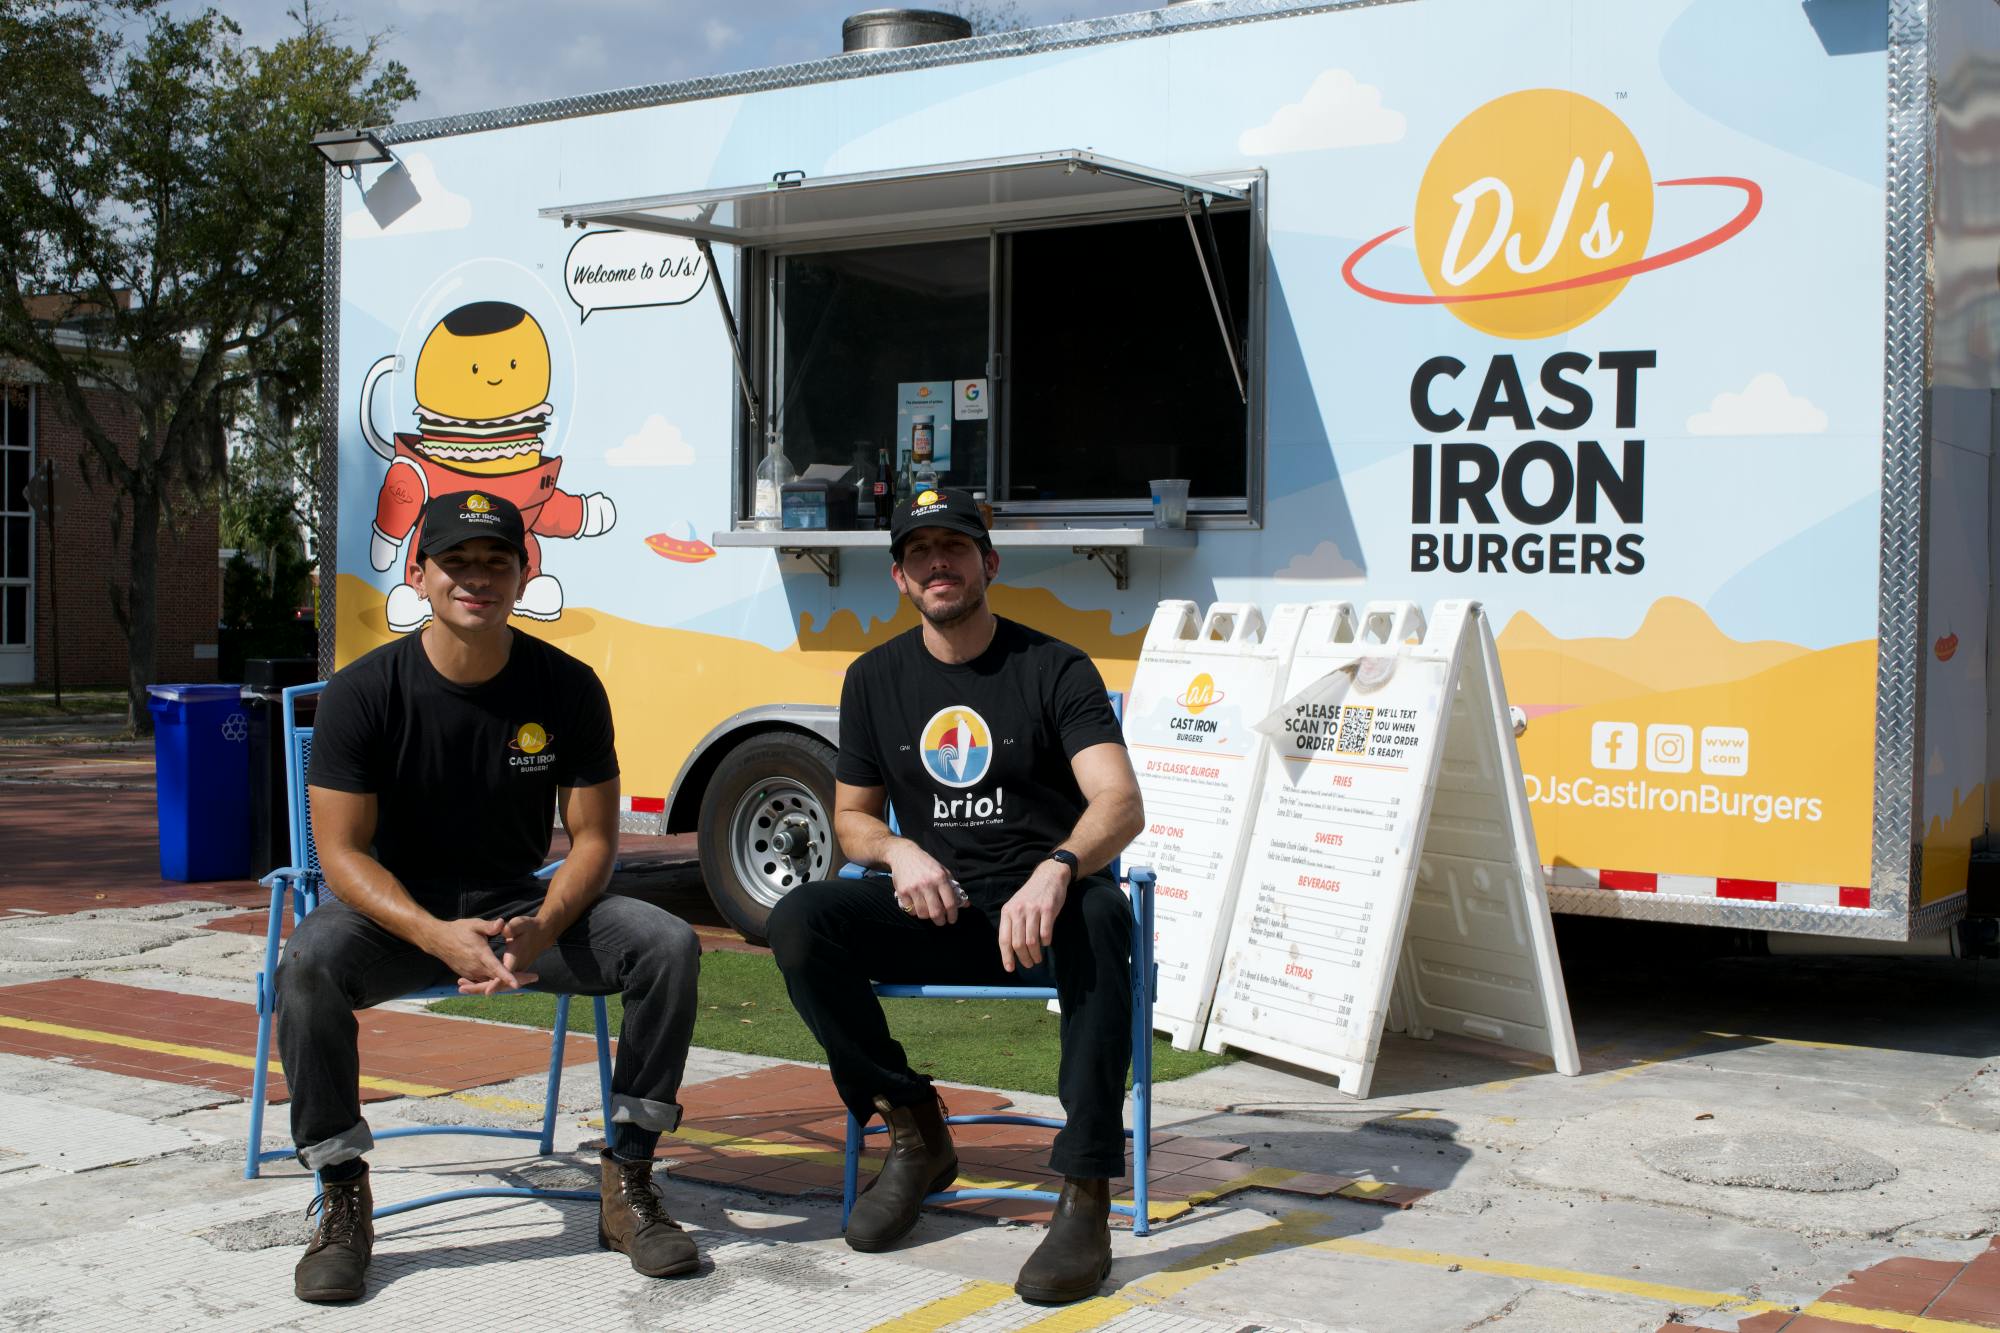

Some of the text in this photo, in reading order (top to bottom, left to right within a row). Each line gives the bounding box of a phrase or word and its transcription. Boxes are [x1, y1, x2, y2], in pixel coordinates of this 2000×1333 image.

[1441, 151, 1625, 286] DJ's
[574, 256, 702, 285] Welcome to DJ's!
[1410, 350, 1657, 434] CAST
[1411, 440, 1645, 526] IRON
[482, 513, 501, 522] IRON
[911, 505, 928, 516] CAST
[1410, 532, 1645, 576] BURGERS
[1296, 703, 1342, 719] PLEASE
[1377, 708, 1417, 720] WE'LL TEXT
[1170, 717, 1218, 733] CAST IRON
[1285, 718, 1338, 735] SCAN TO
[1374, 721, 1416, 733] YOU WHEN
[1176, 733, 1204, 743] BURGERS
[1296, 735, 1335, 751] ORDER
[1372, 734, 1419, 746] YOUR ORDER
[1705, 737, 1744, 748] www
[1368, 747, 1404, 758] IS READY!
[1708, 753, 1741, 764] .com
[509, 756, 535, 766] CAST
[1147, 760, 1220, 778] DJ'S CLASSIC BURGER
[1332, 775, 1353, 788] FRIES
[933, 787, 1003, 819] brio!
[1314, 832, 1344, 846] SWEETS
[1297, 875, 1341, 892] BEVERAGES
[1155, 884, 1188, 900] BURGERS
[1284, 964, 1313, 979] EXTRAS
